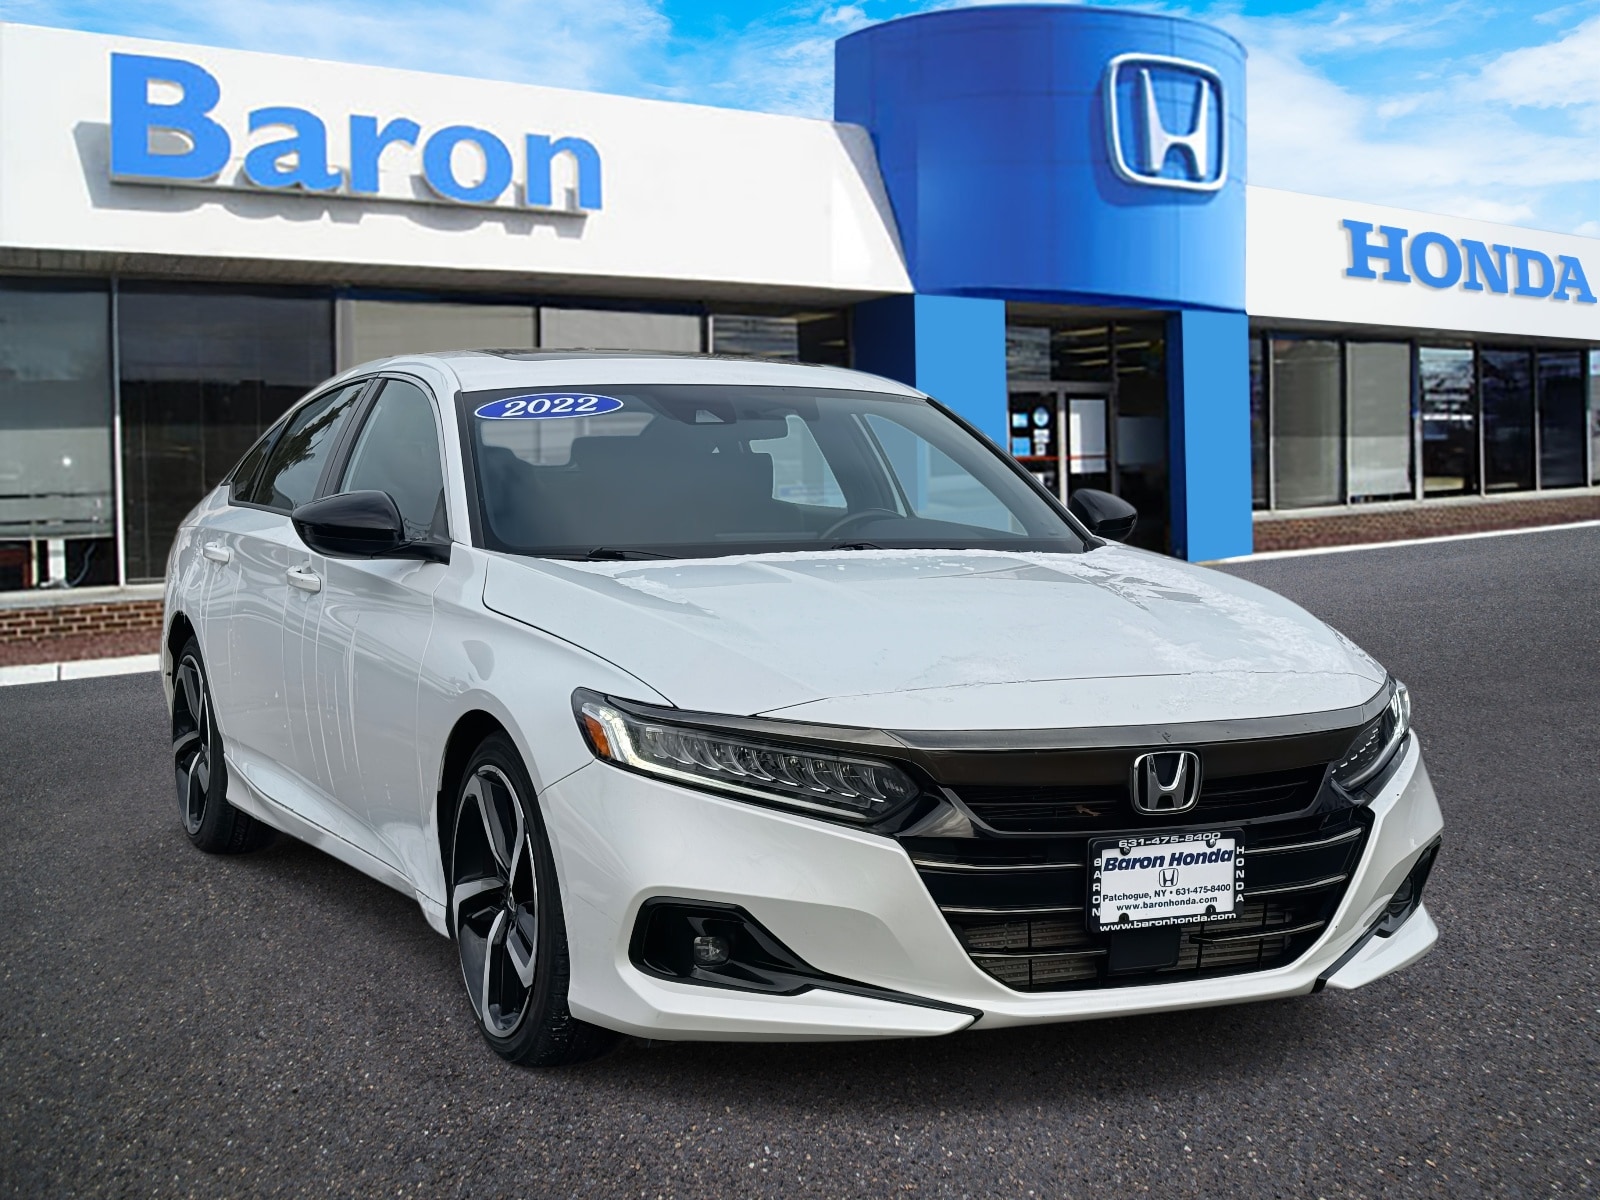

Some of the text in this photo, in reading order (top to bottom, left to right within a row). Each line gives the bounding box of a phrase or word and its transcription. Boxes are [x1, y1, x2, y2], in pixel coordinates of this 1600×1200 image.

[110, 51, 603, 211] Baron
[1342, 218, 1598, 304] HONDA
[501, 396, 599, 418] 2022
[1118, 832, 1221, 848] 631-475-8400
[1102, 848, 1234, 872] Baron Honda
[1235, 845, 1245, 903] HONDA
[1092, 857, 1102, 917] BARON
[1102, 883, 1231, 903] Patchogue, NY 631-475-8400
[1116, 896, 1218, 911] www.baronhonda.com
[1100, 913, 1237, 932] www.baronhonda.com
